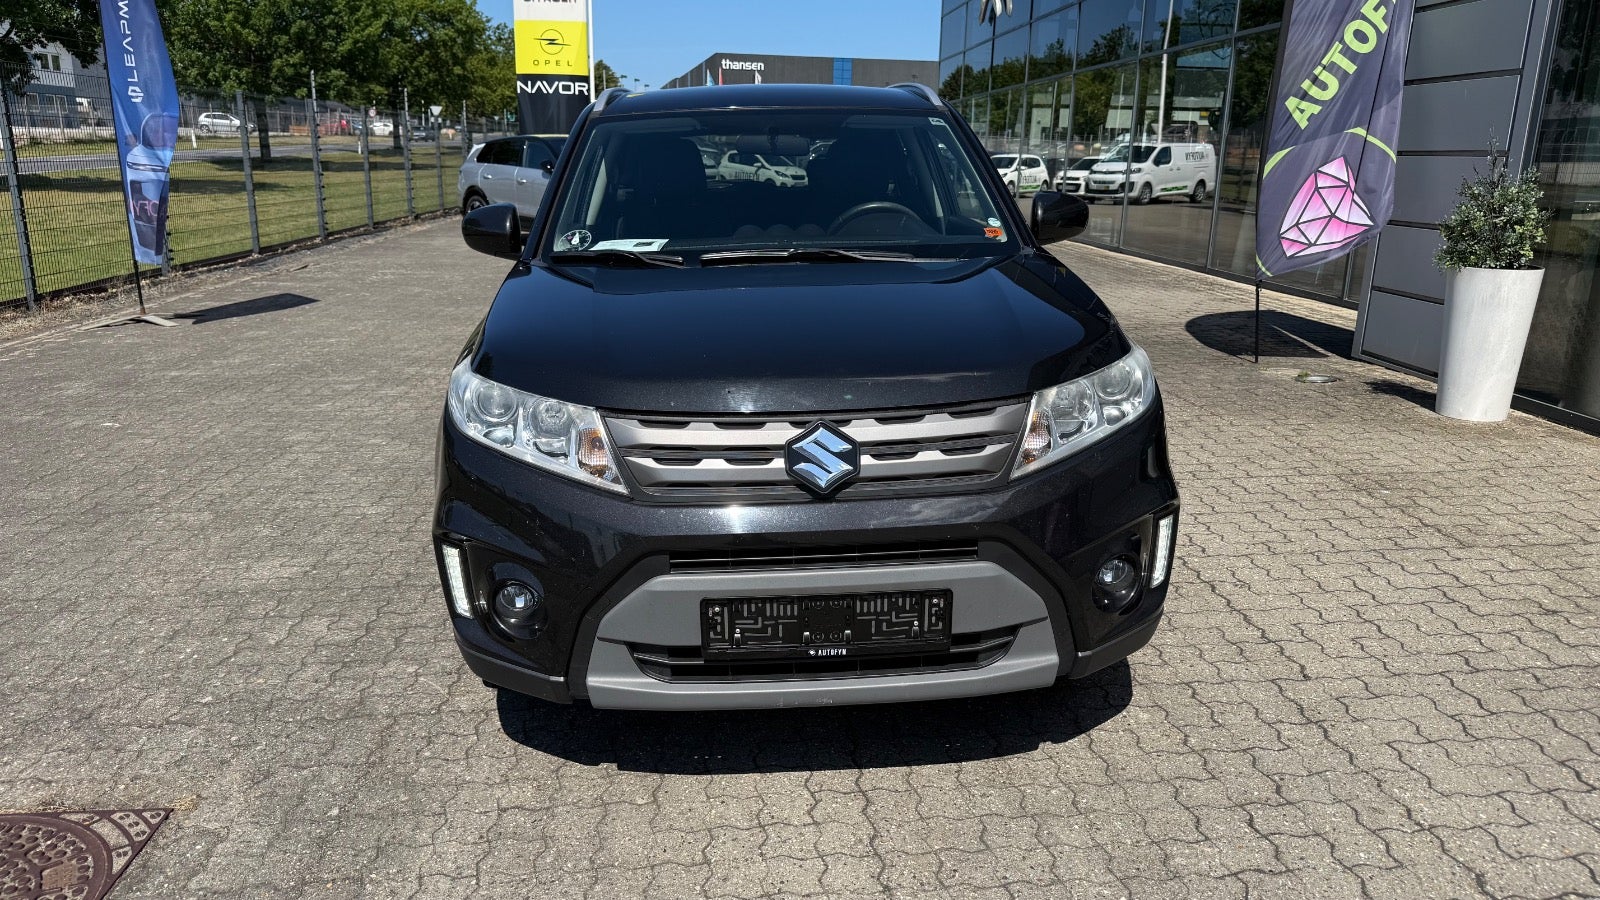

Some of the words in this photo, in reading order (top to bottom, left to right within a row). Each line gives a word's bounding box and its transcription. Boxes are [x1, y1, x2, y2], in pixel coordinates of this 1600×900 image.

[532, 59, 573, 67] OPEL
[721, 58, 765, 71] thansen
[1284, 0, 1396, 130] AUTOF
[516, 80, 589, 95] NAVOR
